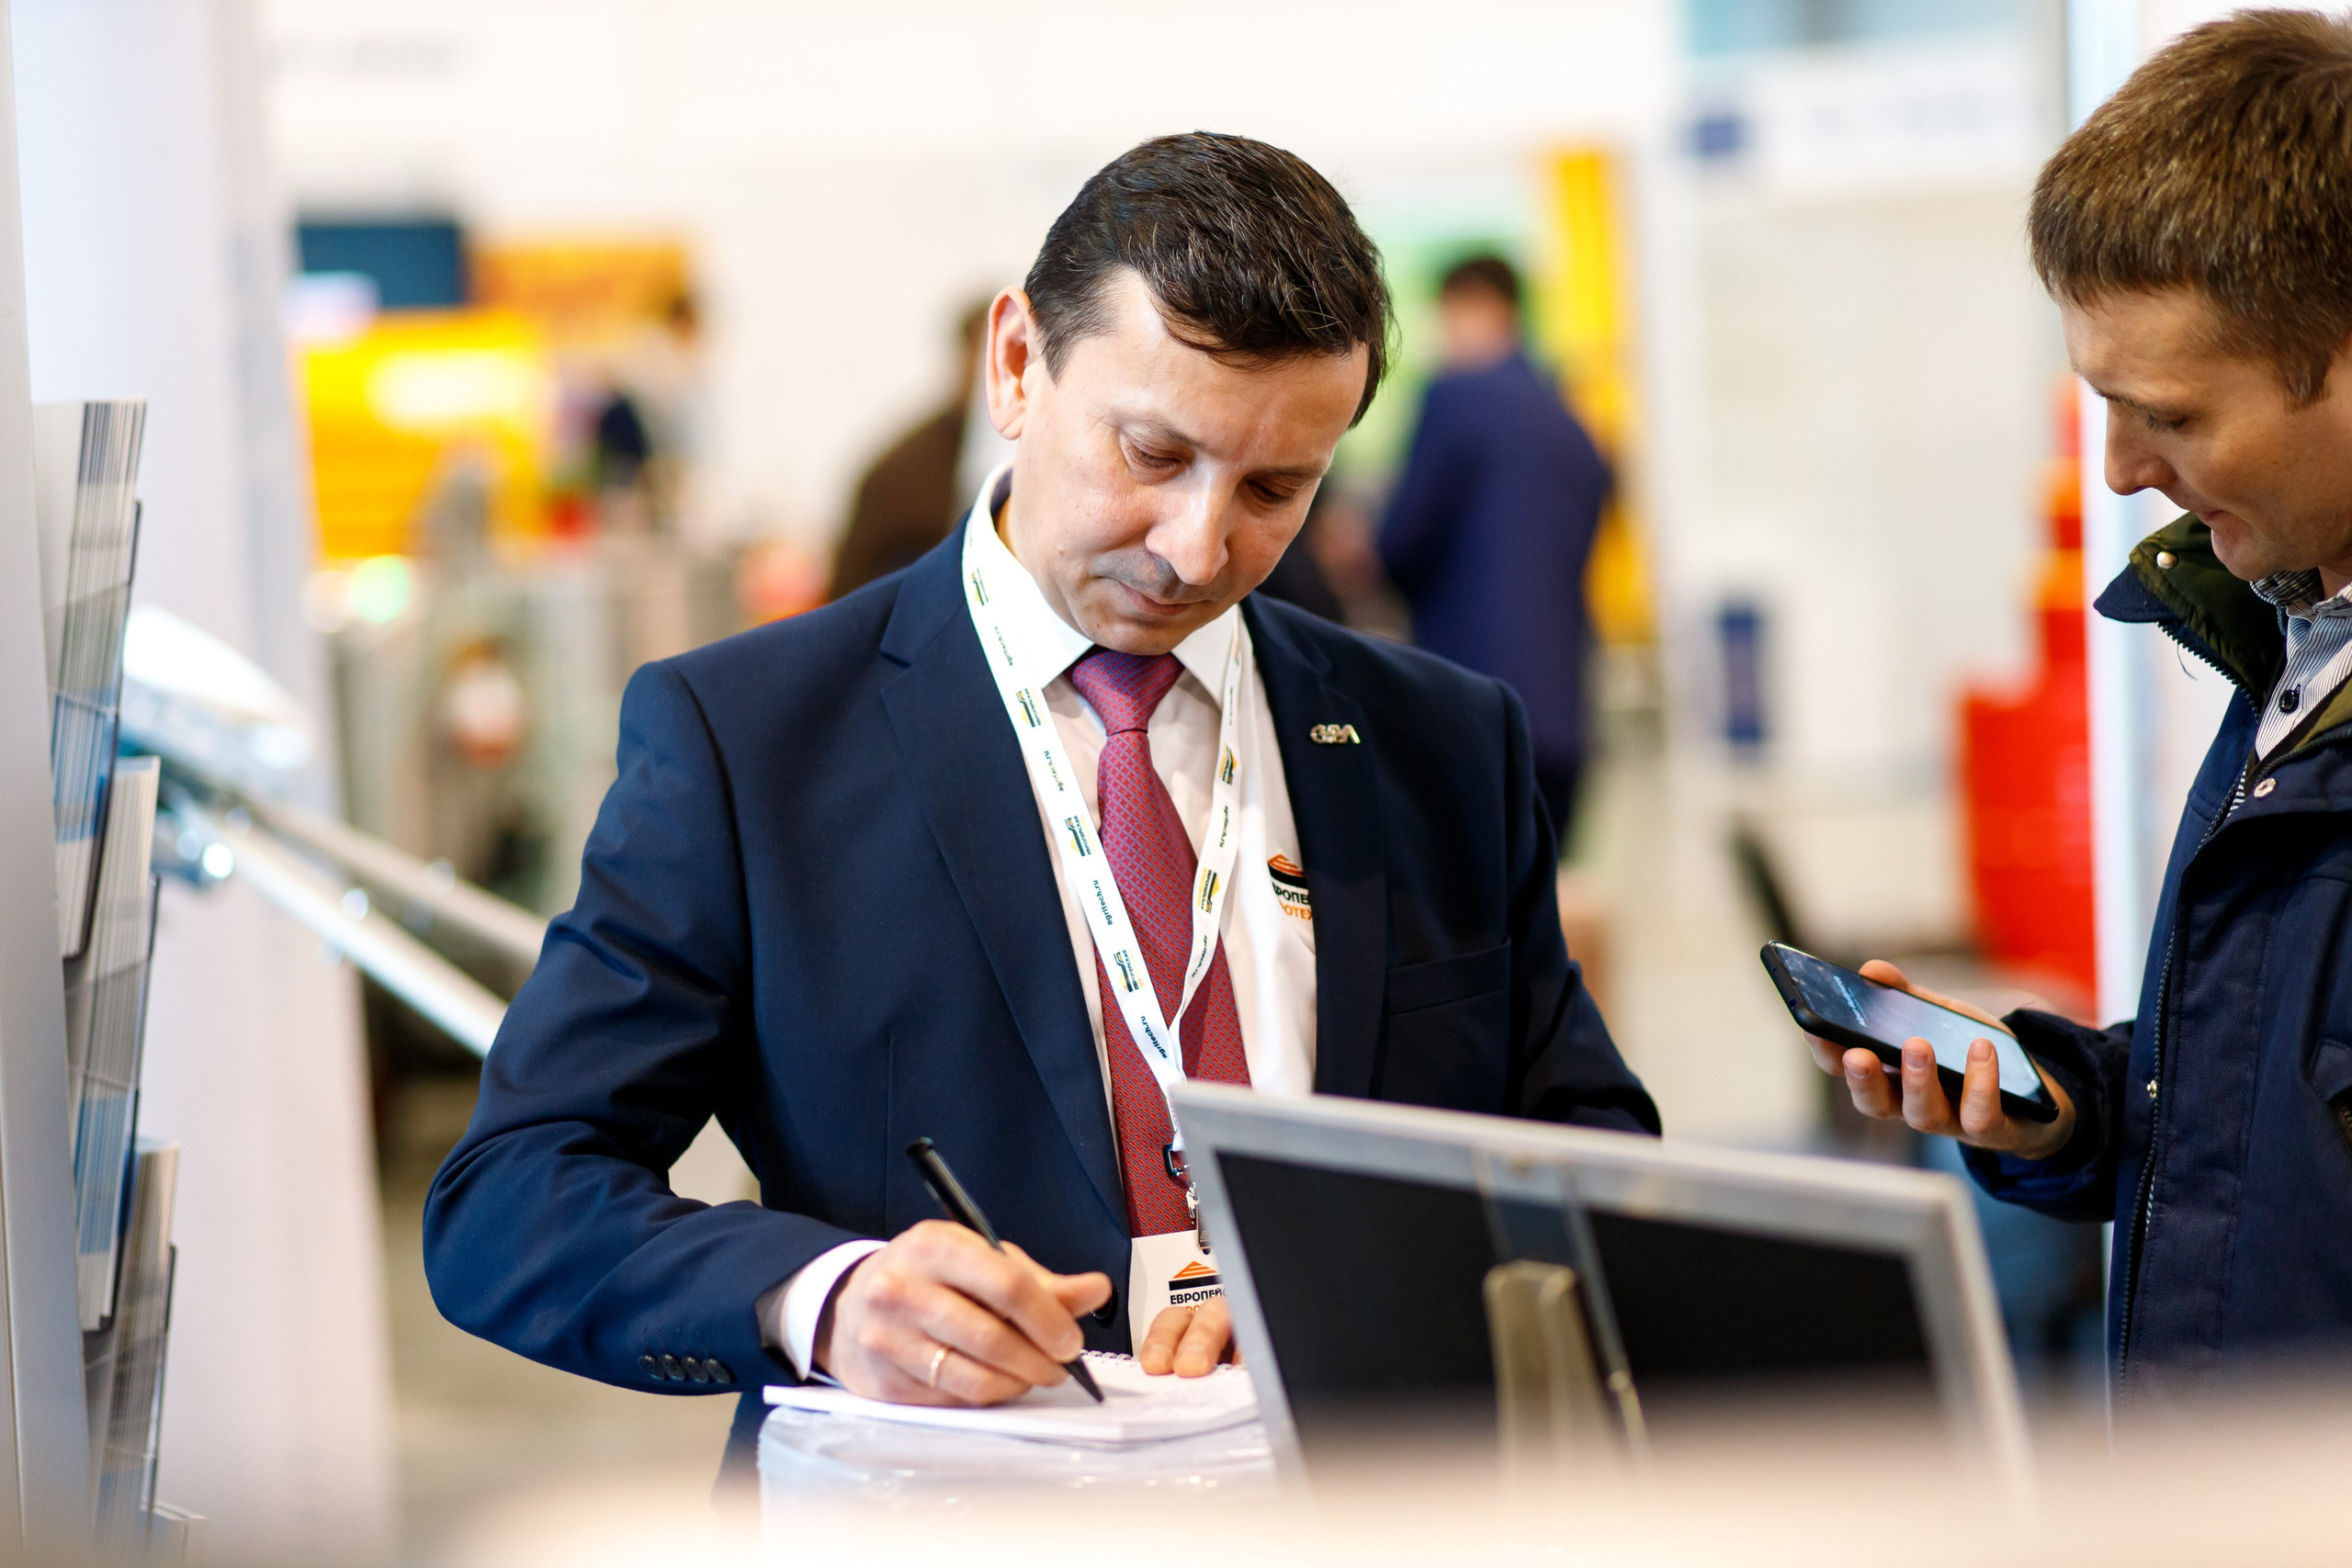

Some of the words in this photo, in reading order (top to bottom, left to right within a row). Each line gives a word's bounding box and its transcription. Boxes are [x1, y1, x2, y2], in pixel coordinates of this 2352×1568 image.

[1044, 750, 1064, 792] agritech.ru
[1092, 879, 1114, 926] agritech.ru
[1272, 882, 1310, 905] РОПЕ
[1140, 1015, 1169, 1059] agritech.ru
